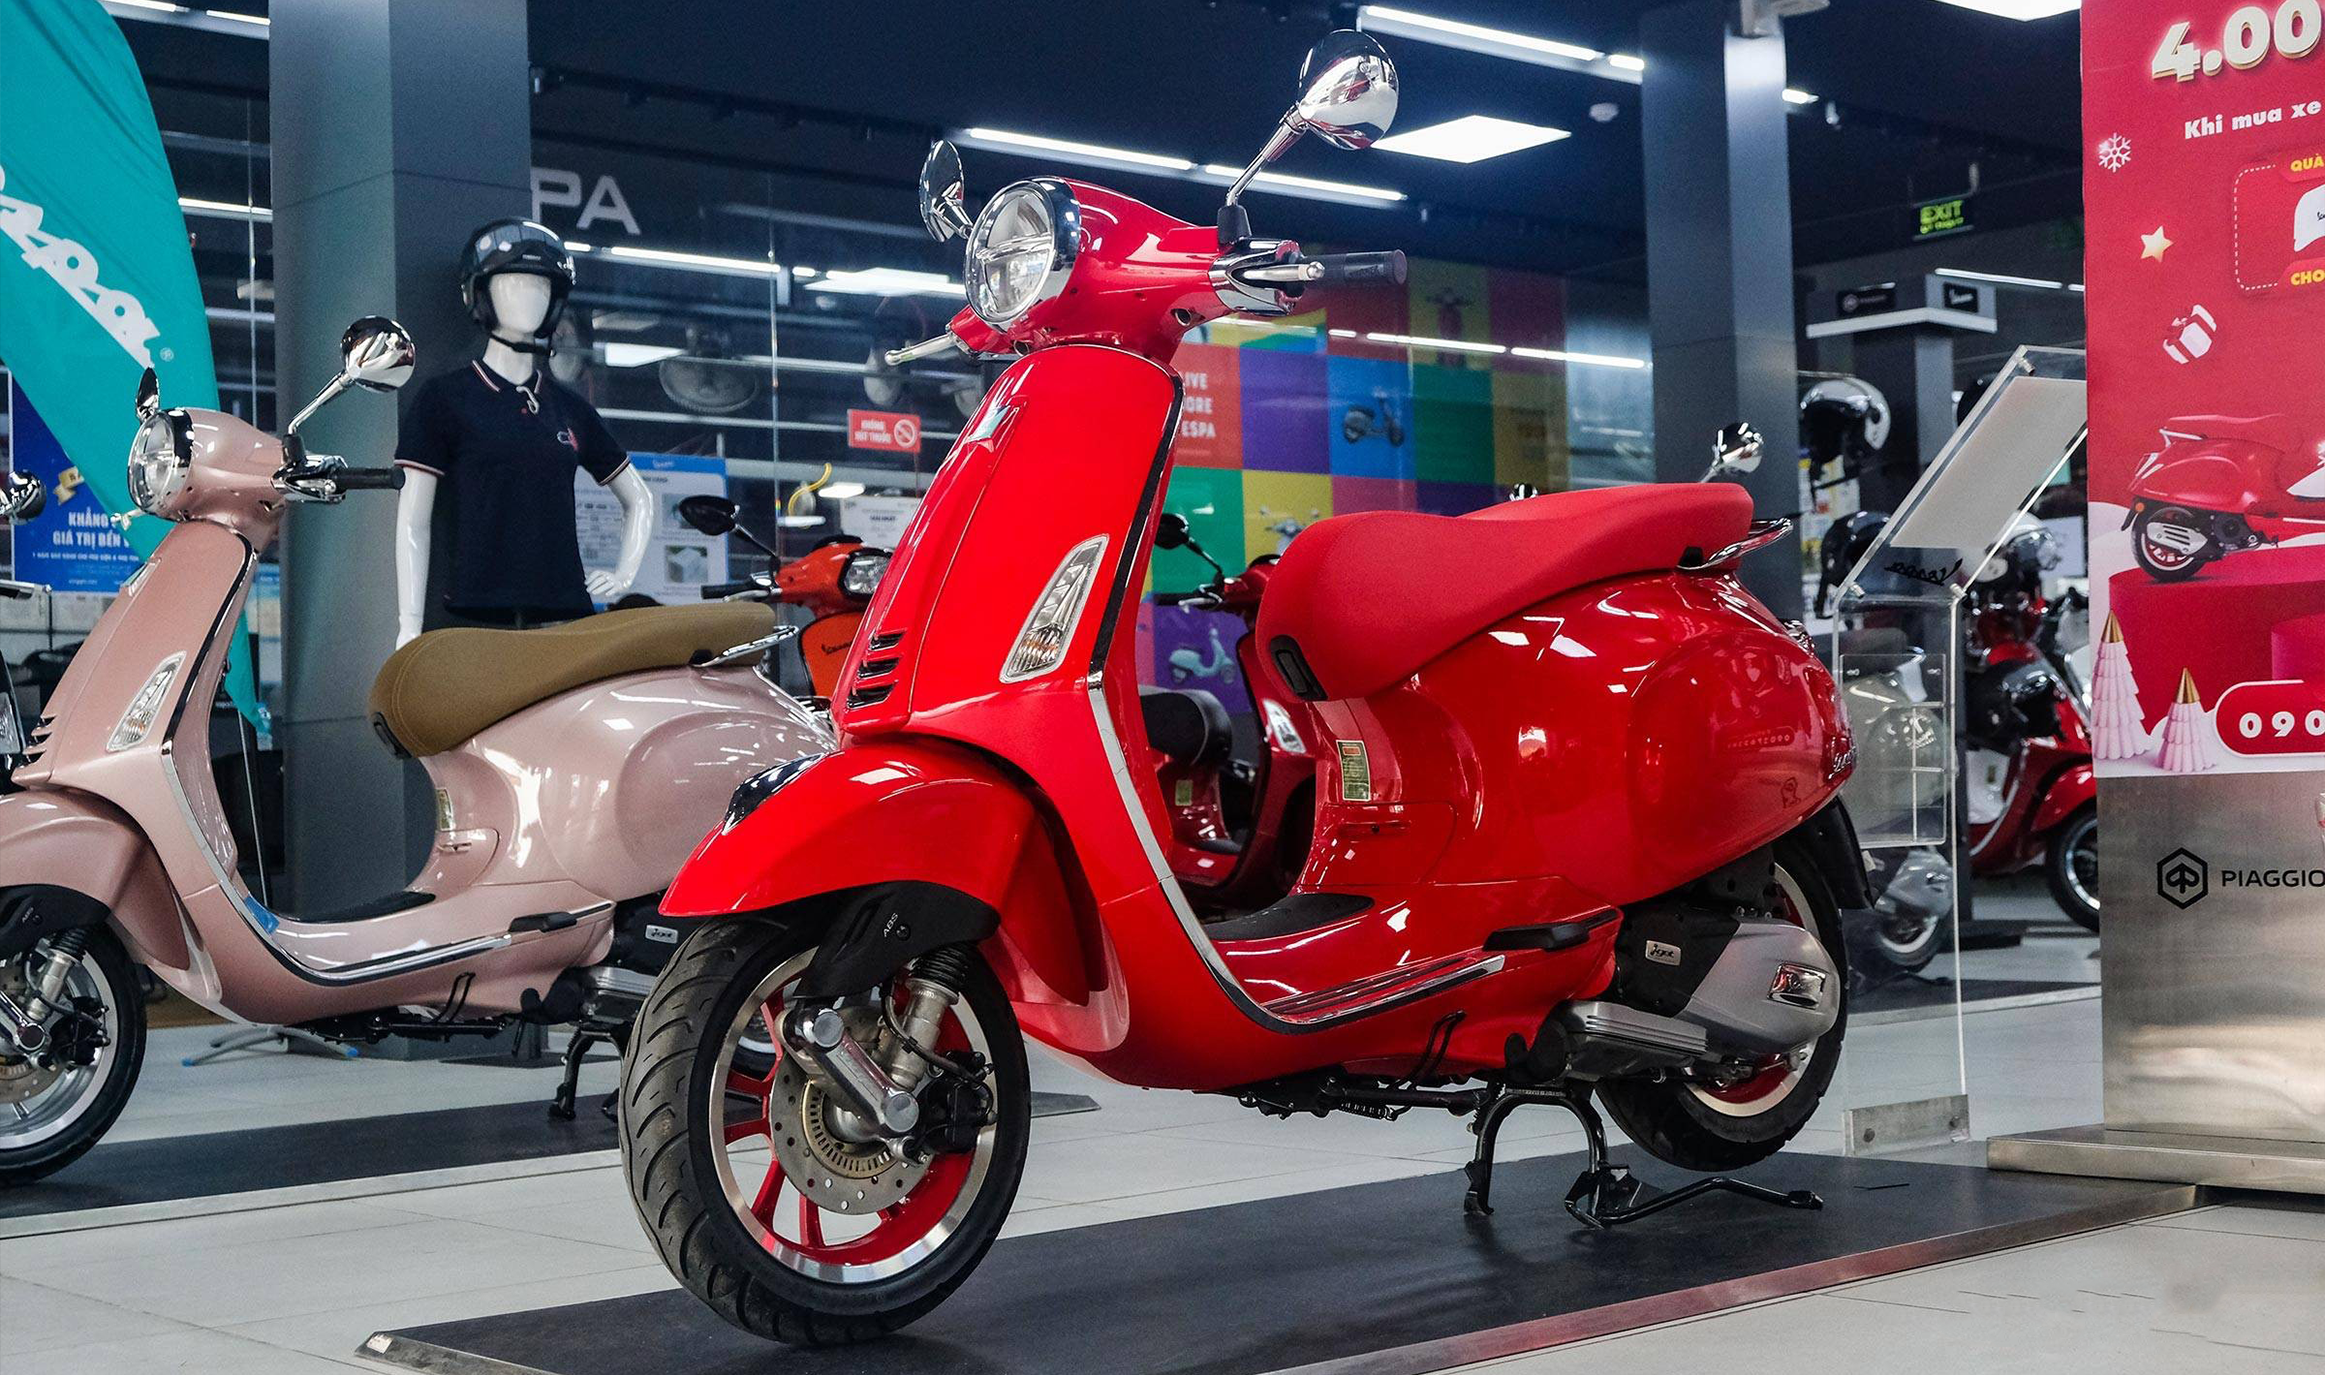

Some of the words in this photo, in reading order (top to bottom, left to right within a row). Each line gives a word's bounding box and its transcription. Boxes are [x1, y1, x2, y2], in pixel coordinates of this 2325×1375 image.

[2151, 0, 2322, 83] 4.00
[2185, 114, 2223, 140] Khi
[2231, 107, 2282, 131] mua
[2291, 100, 2322, 119] xe
[1920, 199, 1963, 225] EXIT
[2290, 269, 2325, 286] CHO
[2221, 869, 2325, 888] PIAGGIO
[883, 912, 899, 938] ABS
